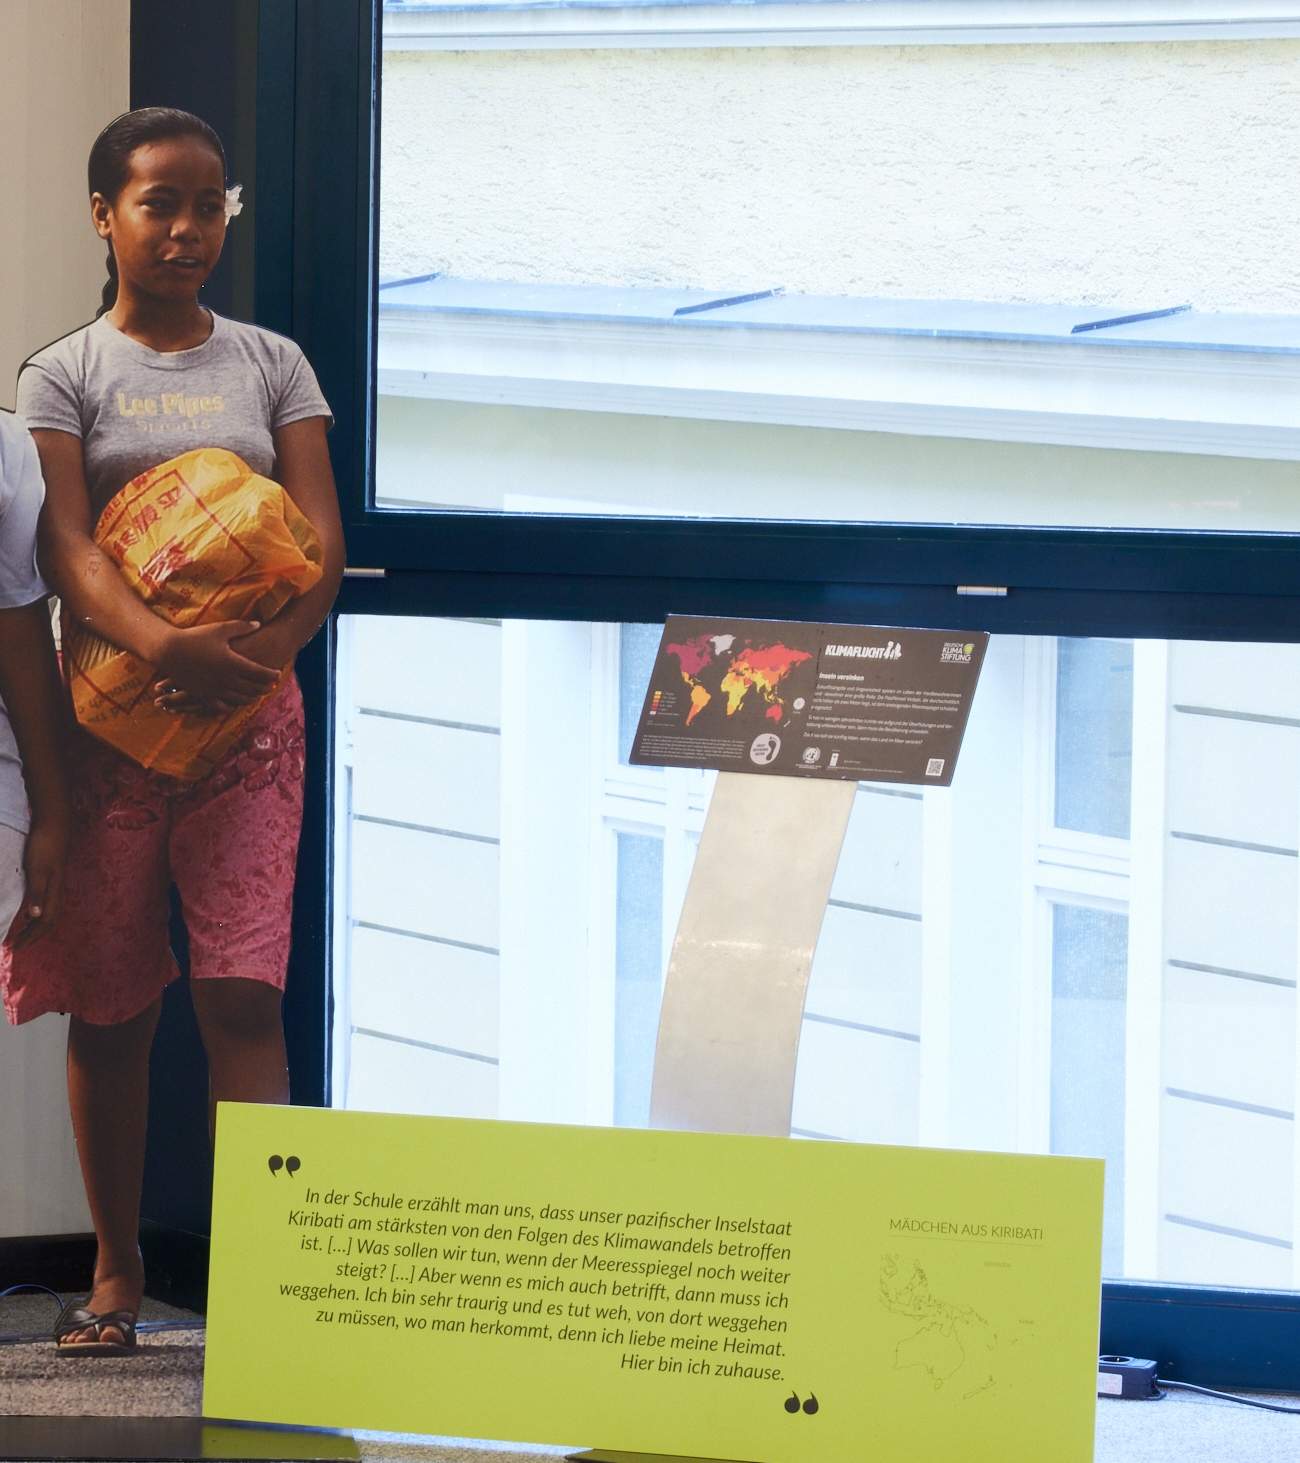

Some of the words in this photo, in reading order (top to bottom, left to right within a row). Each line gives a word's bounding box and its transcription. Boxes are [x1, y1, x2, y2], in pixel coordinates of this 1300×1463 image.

[117, 392, 157, 417] Lee
[161, 390, 225, 418] Pipes
[825, 644, 884, 658] KLIMAFLUCHT
[941, 653, 971, 661] STIFTUNG
[288, 1210, 345, 1229] Kiribati
[347, 1218, 372, 1231] am
[376, 1217, 447, 1236] stärksten
[451, 1225, 480, 1238] von
[483, 1223, 513, 1241] den
[517, 1226, 568, 1247] Folgen
[572, 1229, 599, 1247] des
[603, 1232, 714, 1255] Klimawandels
[717, 1239, 791, 1261] betroffen
[305, 1188, 320, 1204] In
[324, 1189, 350, 1205] der
[352, 1191, 404, 1209] Schule
[407, 1196, 461, 1213] erzählt
[465, 1202, 499, 1216] man
[503, 1205, 534, 1220] uns,
[539, 1203, 575, 1221] dass
[579, 1210, 623, 1224] unser
[625, 1211, 712, 1230] pazifischer
[715, 1215, 792, 1236] Inselstaat
[889, 1217, 958, 1235] MÄDCHEN
[961, 1223, 988, 1237] AUS
[991, 1225, 1043, 1241] KIRIBATI
[300, 1234, 322, 1251] ist.
[357, 1238, 390, 1256] Was
[393, 1241, 438, 1259] sollen
[443, 1245, 468, 1261] wir
[471, 1247, 500, 1266] tun,
[505, 1253, 548, 1267] wenn
[551, 1252, 579, 1269] der
[581, 1254, 693, 1280] Meeresspiegel
[696, 1264, 736, 1281] noch
[740, 1267, 791, 1284] weiter
[279, 1283, 359, 1301] weggehen.
[364, 1286, 387, 1303] Ich
[391, 1288, 416, 1305] bin
[419, 1291, 454, 1308] sehr
[456, 1294, 509, 1315] traurig
[512, 1298, 543, 1315] und
[546, 1303, 564, 1316] es
[568, 1302, 591, 1318] tut
[595, 1304, 631, 1324] weh,
[636, 1310, 665, 1324] von
[669, 1308, 704, 1327] dort
[707, 1314, 788, 1333] weggehen
[335, 1262, 387, 1282] steigt?
[418, 1266, 457, 1284] Aber
[460, 1273, 502, 1288] wenn
[506, 1277, 523, 1289] es
[526, 1275, 565, 1292] mich
[568, 1279, 607, 1295] auch
[611, 1280, 670, 1302] betrifft,
[675, 1285, 715, 1303] dann
[720, 1292, 761, 1307] muss
[765, 1291, 789, 1309] ich
[315, 1310, 334, 1323] zu
[338, 1309, 399, 1330] müssen,
[404, 1317, 427, 1330] wo
[431, 1319, 465, 1333] man
[469, 1317, 553, 1341] herkommt,
[557, 1324, 597, 1342] denn
[601, 1327, 624, 1345] ich
[628, 1329, 666, 1348] liebe
[670, 1334, 719, 1352] meine
[723, 1337, 785, 1357] Heimat.
[620, 1353, 655, 1371] Hier
[658, 1355, 683, 1373] bin
[687, 1358, 711, 1375] ich
[714, 1361, 784, 1381] zuhause.
